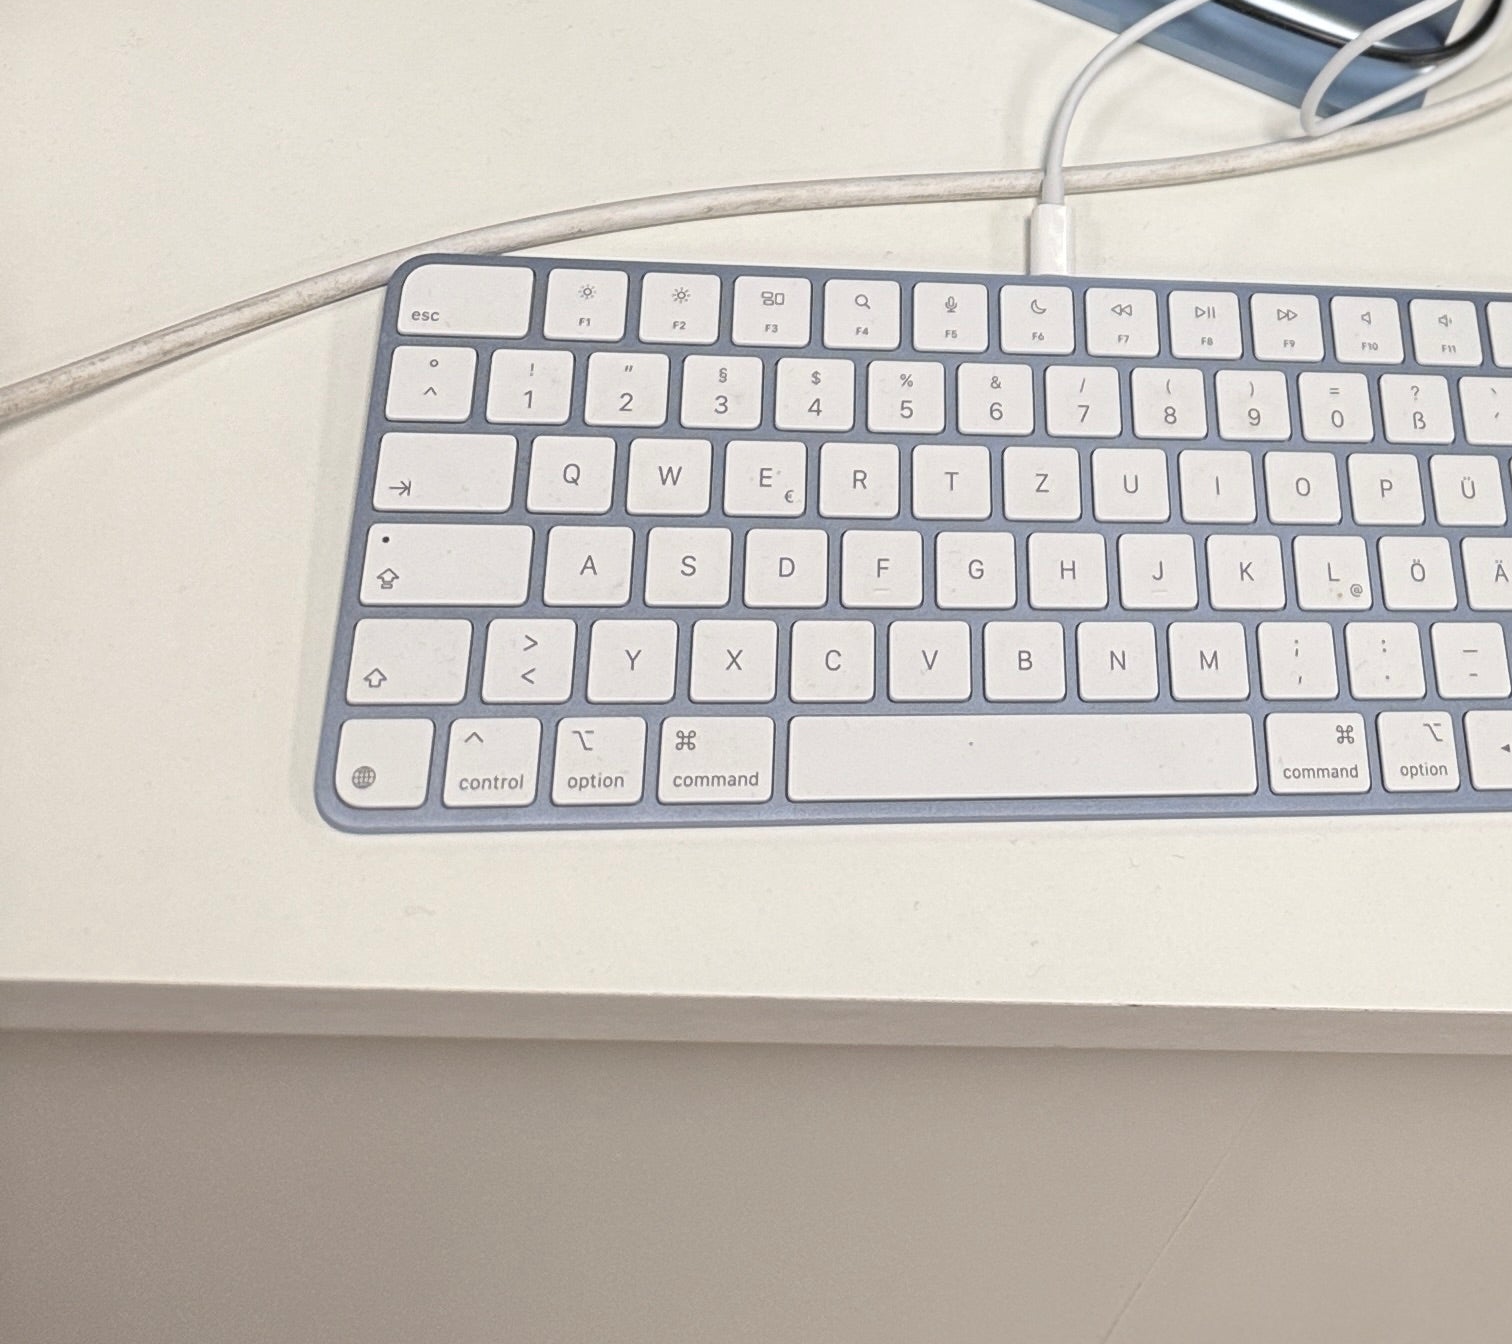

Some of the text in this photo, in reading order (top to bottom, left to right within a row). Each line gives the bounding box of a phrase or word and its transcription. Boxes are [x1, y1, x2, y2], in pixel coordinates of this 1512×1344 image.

[412, 311, 439, 321] esc
[579, 318, 590, 326] F1
[673, 321, 686, 330] F2
[765, 324, 778, 333] F3
[856, 327, 868, 335] F4
[945, 330, 957, 338] F5
[1032, 332, 1044, 340] F6
[1118, 335, 1129, 343] F7
[1201, 337, 1213, 346] F8
[1362, 342, 1378, 350] F10
[524, 390, 532, 408] 1
[619, 393, 633, 411] 2
[715, 395, 728, 414] 3
[808, 398, 822, 416] 4
[901, 400, 913, 419] 5
[990, 402, 1003, 420] 6
[1078, 405, 1089, 422] 7
[1164, 406, 1177, 424] 8
[1248, 408, 1260, 426] 9
[1331, 410, 1344, 428] 0
[1413, 411, 1426, 429] ß
[563, 464, 580, 485] Q
[659, 466, 682, 486] W
[760, 468, 772, 487] E
[853, 470, 867, 489] R
[945, 472, 959, 491] T
[1036, 474, 1049, 492] Z
[1124, 475, 1138, 493] U
[1216, 477, 1220, 495] I
[1296, 478, 1310, 496] O
[1380, 479, 1392, 498] P
[1461, 475, 1475, 499] Ü
[580, 555, 597, 575] A
[681, 556, 696, 576] S
[779, 557, 795, 577] D
[877, 559, 889, 578] F
[969, 559, 984, 579] G
[1061, 560, 1075, 579] H
[1152, 561, 1163, 580] J
[1240, 562, 1254, 581] K
[1328, 563, 1340, 581] L
[1411, 559, 1425, 582] Ö
[1495, 559, 1509, 582] Ä
[625, 650, 641, 671] Y
[726, 650, 742, 670] X
[825, 650, 841, 671] C
[922, 650, 938, 670] V
[1018, 650, 1032, 670] B
[1110, 651, 1125, 670] N
[1200, 651, 1218, 670] M
[673, 772, 758, 787] command
[1283, 764, 1358, 779] command
[1400, 764, 1448, 779] option
[459, 774, 523, 790] control
[568, 775, 624, 791] option
